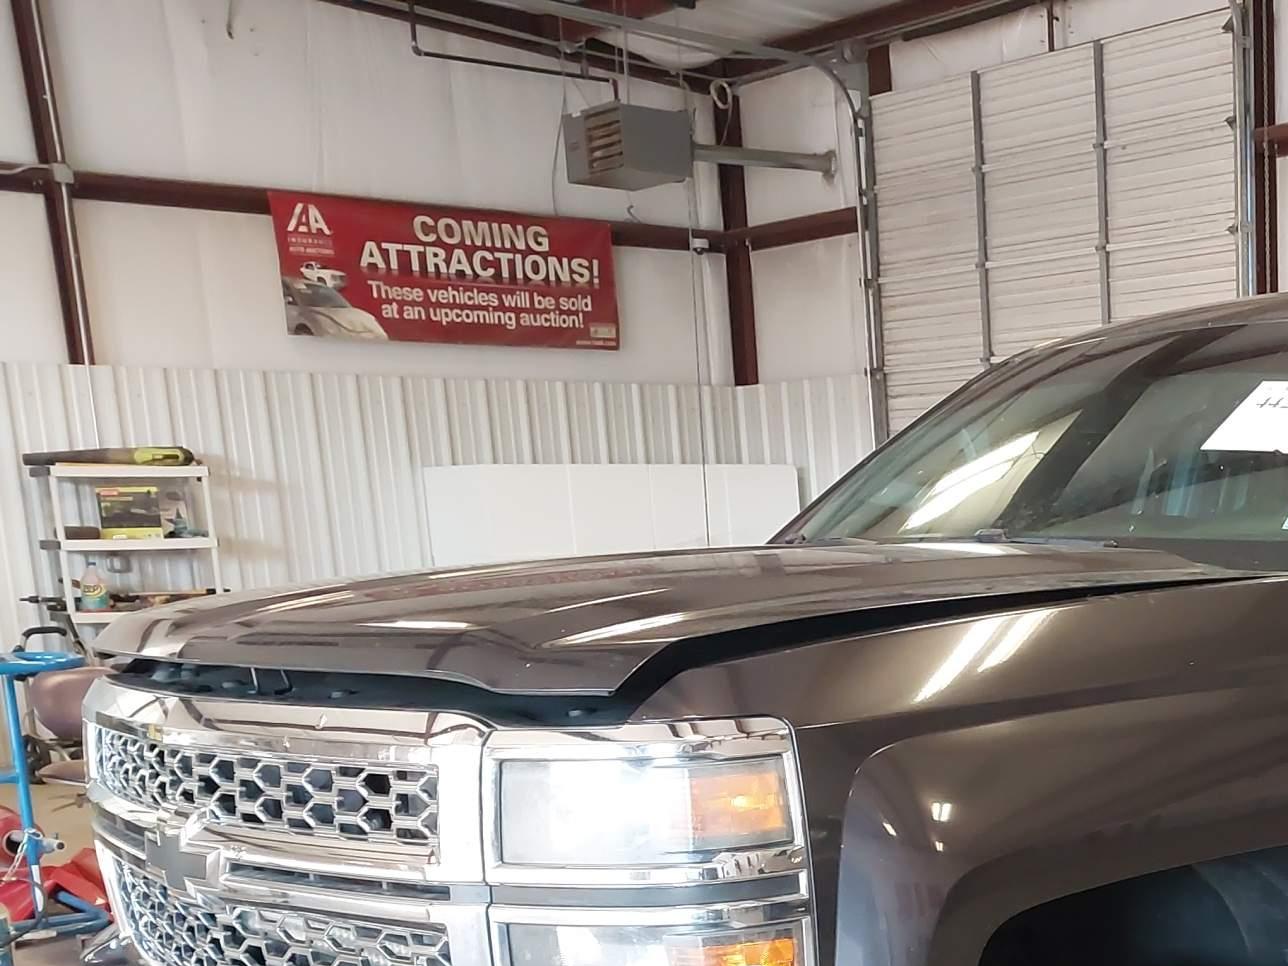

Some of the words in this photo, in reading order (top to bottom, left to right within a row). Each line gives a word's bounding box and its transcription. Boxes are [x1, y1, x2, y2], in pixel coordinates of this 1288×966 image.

[413, 215, 549, 252] COMING
[360, 240, 599, 284] ATTRACTIONS!
[367, 280, 424, 301] These
[427, 286, 499, 307] vehicles
[502, 291, 530, 309] will
[533, 292, 556, 310] be
[559, 294, 593, 312] sold
[381, 302, 400, 319] at
[403, 305, 426, 320] an
[429, 307, 516, 330] upcoming
[520, 311, 585, 329] auction!
